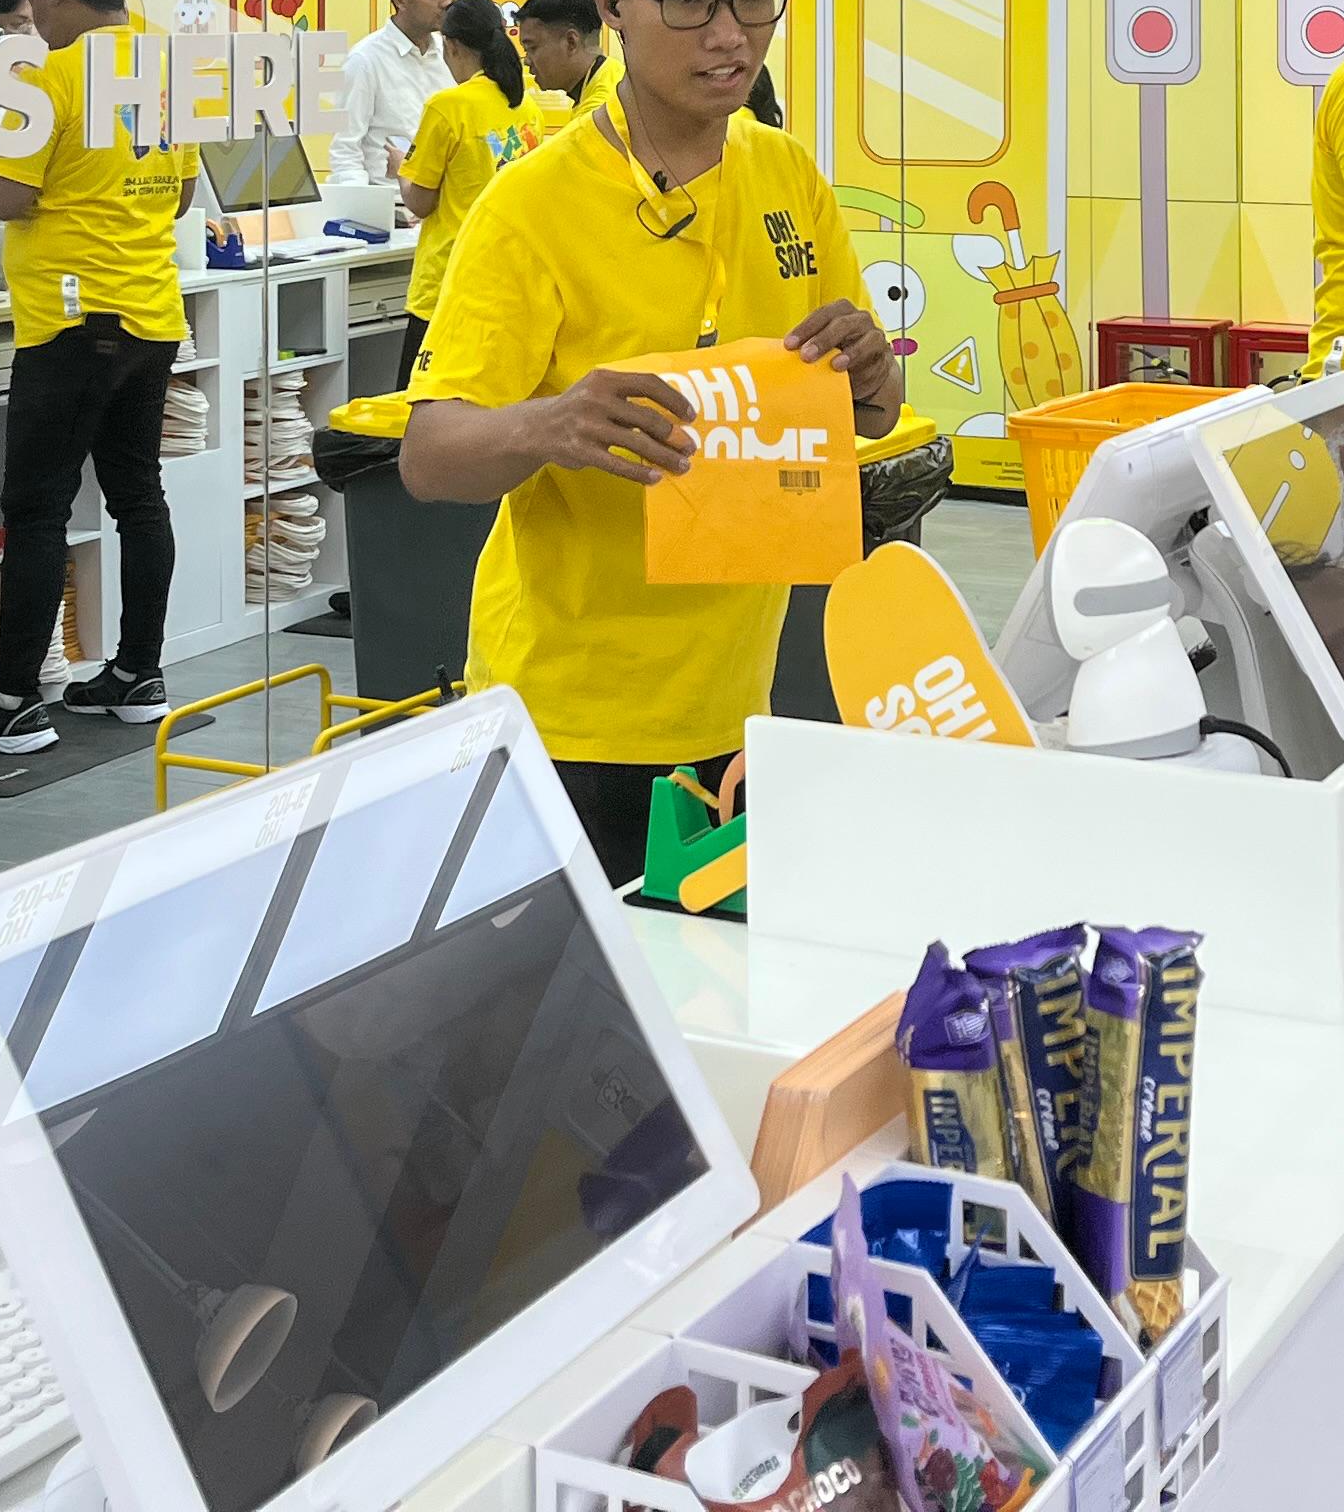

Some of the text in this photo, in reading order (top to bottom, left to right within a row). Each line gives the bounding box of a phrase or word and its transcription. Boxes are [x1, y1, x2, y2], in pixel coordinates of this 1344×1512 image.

[84, 30, 347, 149] HERE
[763, 209, 799, 244] OH!
[775, 241, 817, 279] SOME
[1148, 966, 1197, 1259] IMPERIAL
